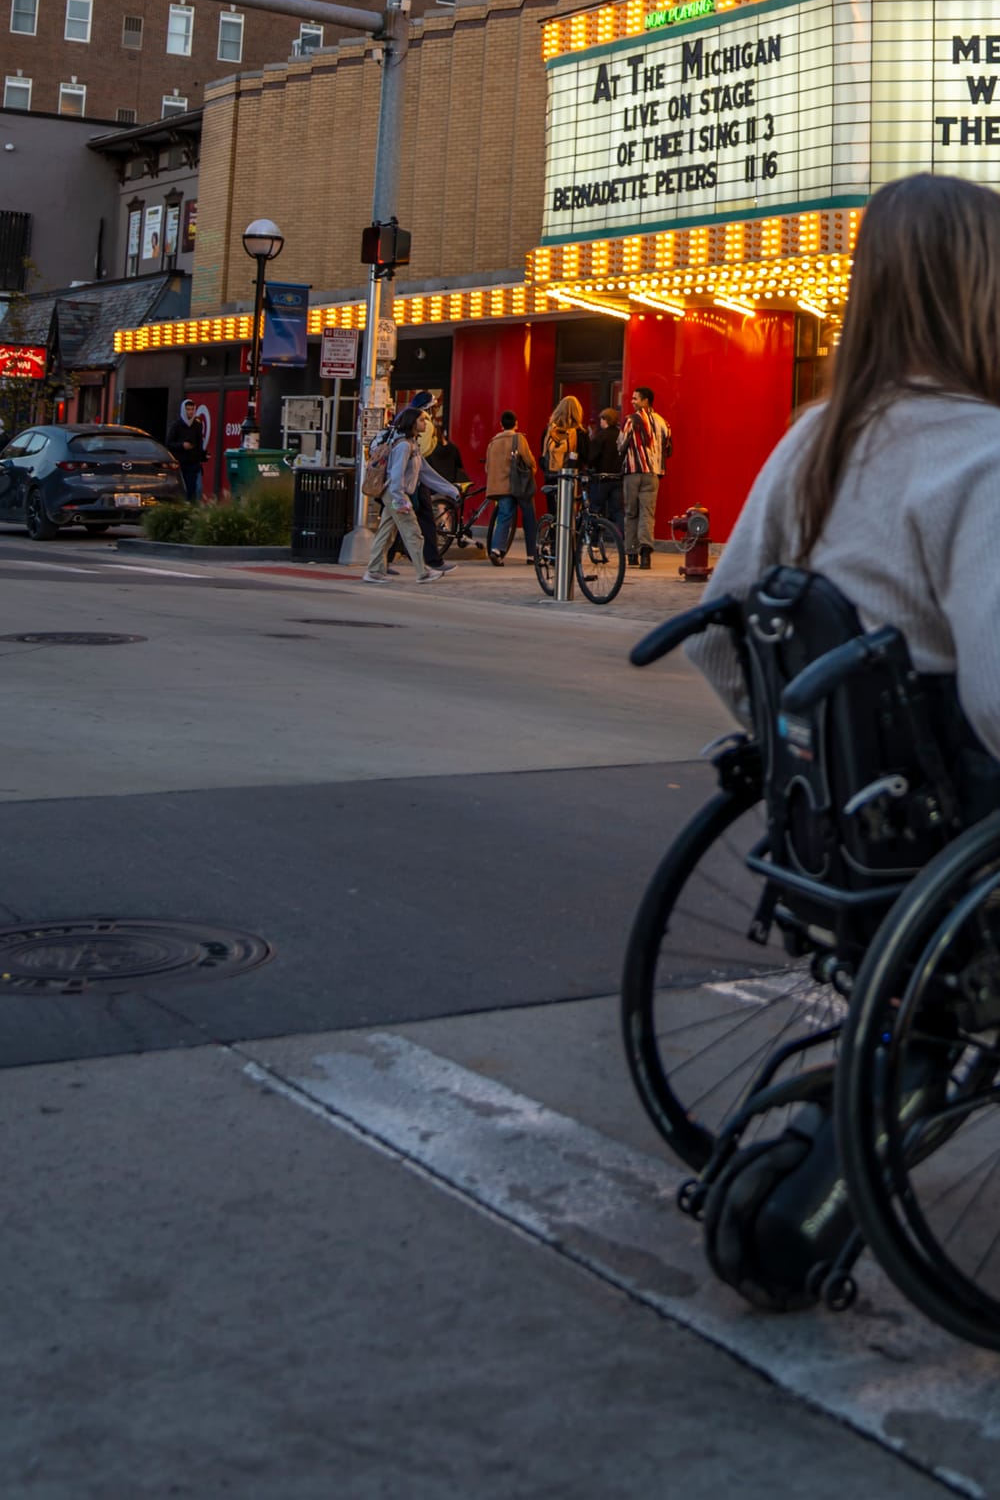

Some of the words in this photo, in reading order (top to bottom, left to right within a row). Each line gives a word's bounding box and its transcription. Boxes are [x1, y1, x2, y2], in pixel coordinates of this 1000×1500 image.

[645, 11, 666, 28] NOW
[624, 100, 660, 131] LIVE
[668, 93, 691, 121] ON
[700, 79, 755, 115] STAGE
[617, 140, 637, 167] OF
[643, 130, 684, 163] THEE
[689, 129, 694, 154] I
[700, 120, 739, 151] SING
[763, 113, 774, 141] 3
[553, 173, 649, 212] BERNADETTE
[655, 161, 717, 197] PETERS
[762, 151, 778, 180] 16
